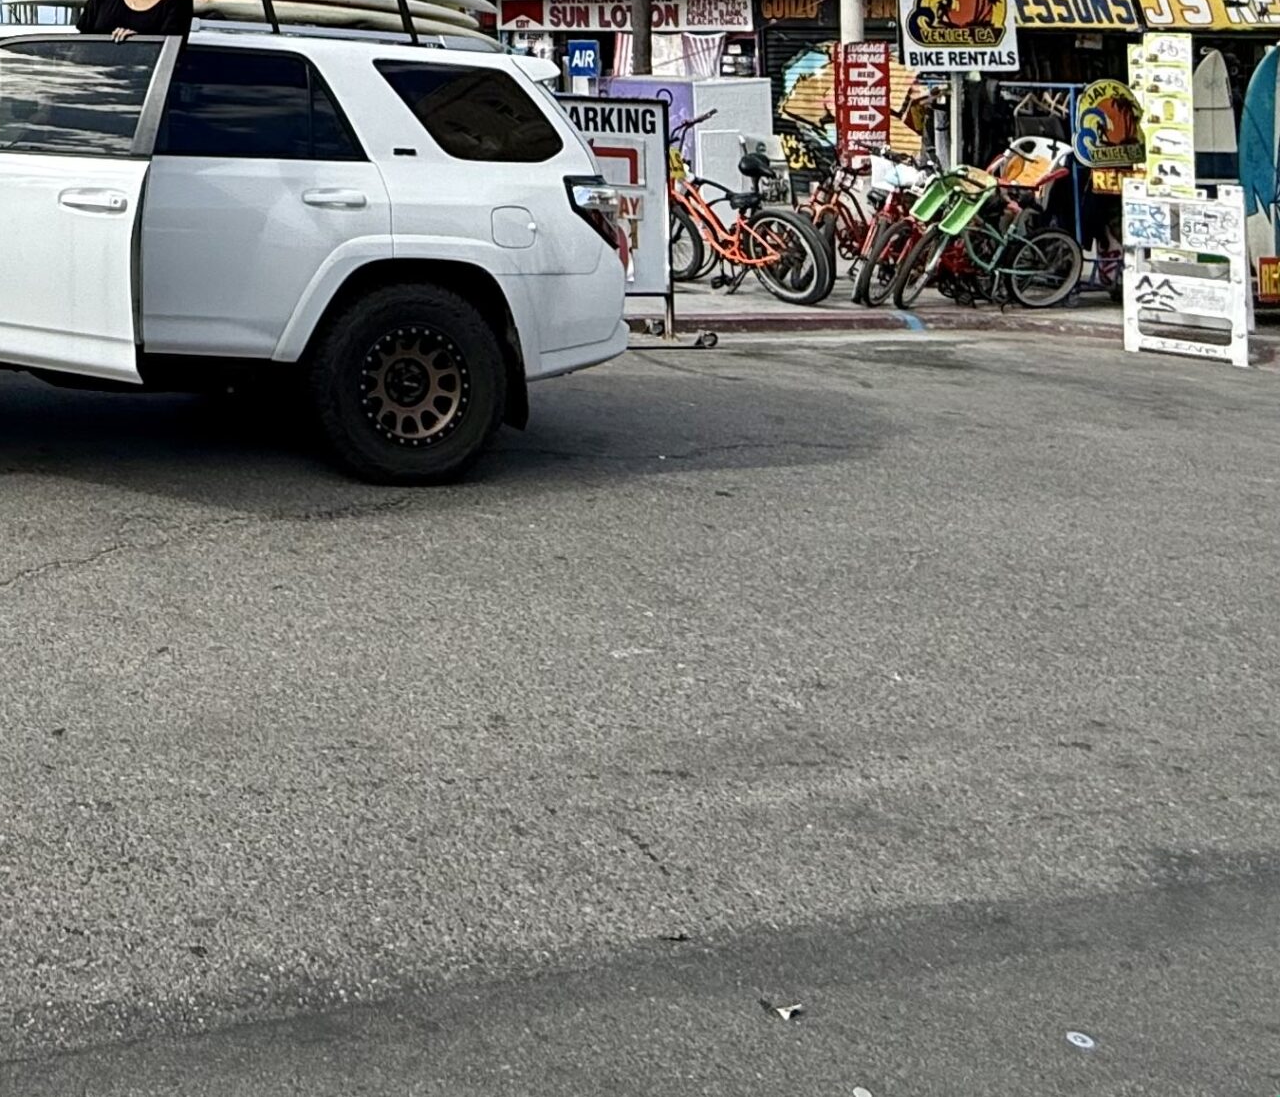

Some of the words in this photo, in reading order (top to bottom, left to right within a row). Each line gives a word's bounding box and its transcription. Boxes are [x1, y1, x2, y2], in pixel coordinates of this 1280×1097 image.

[549, 5, 590, 28] SUN
[599, 3, 679, 28] LOON
[975, 28, 995, 42] CA
[847, 43, 886, 53] LUGGAGE
[571, 49, 596, 68] AIR
[847, 54, 886, 63] STORAGE
[909, 51, 945, 67] BIKE
[948, 51, 1016, 67] RENTALS
[847, 86, 887, 96] LUGGAGE
[1087, 85, 1122, 106] JAY'S
[847, 96, 887, 106] STORAGE
[847, 131, 887, 141] LUGGAGE
